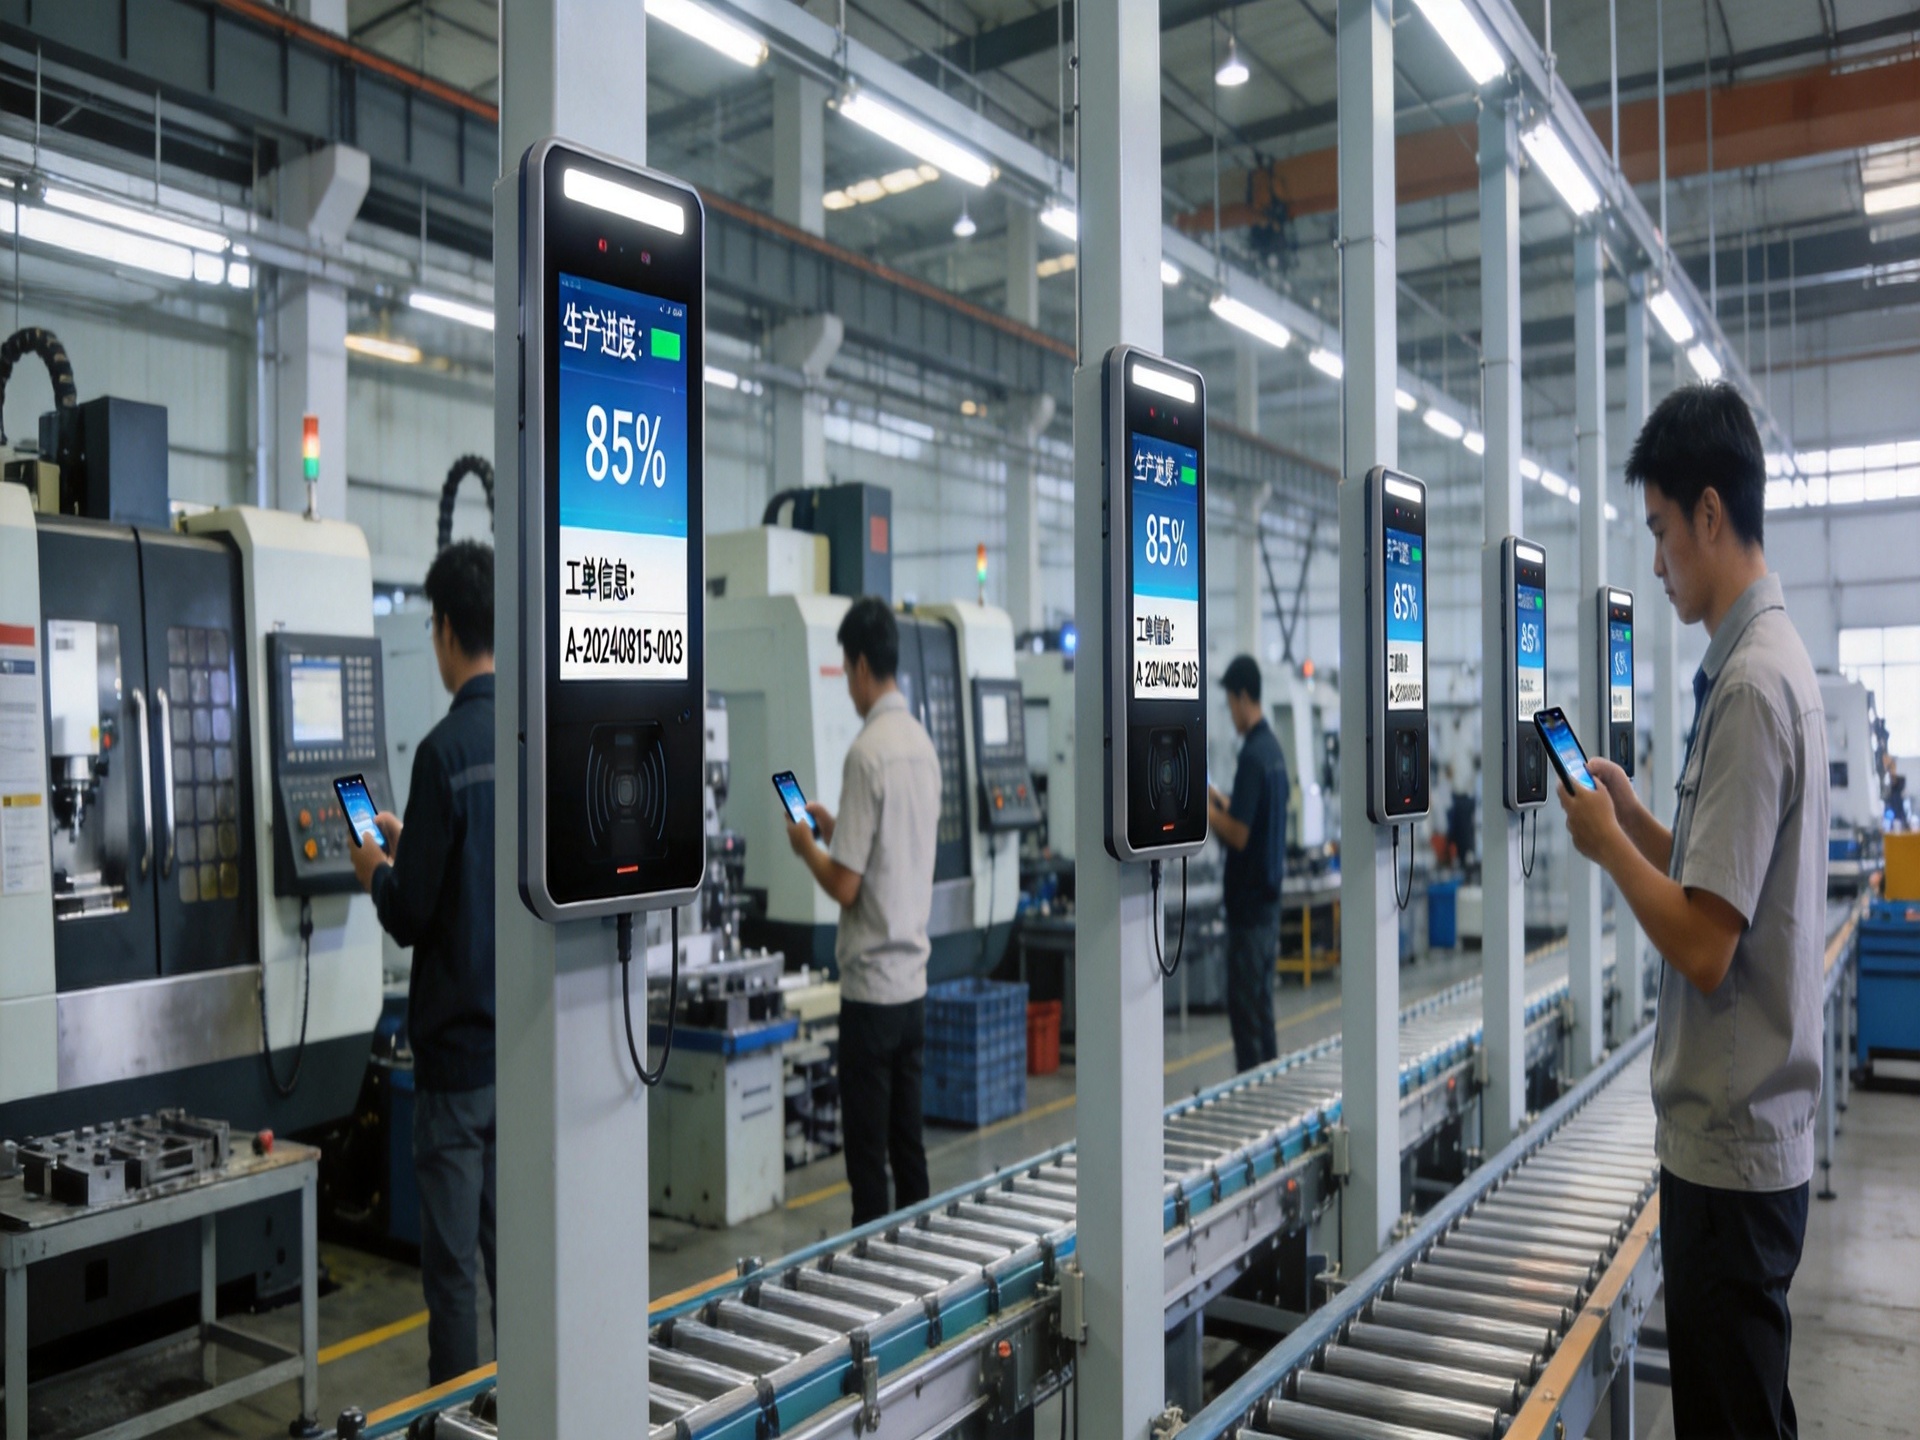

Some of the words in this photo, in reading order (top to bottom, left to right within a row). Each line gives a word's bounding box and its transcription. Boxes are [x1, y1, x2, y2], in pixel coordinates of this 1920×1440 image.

[563, 301, 643, 361] 生产进度：
[585, 404, 666, 489] 85%
[1145, 513, 1188, 567] 85%
[566, 555, 635, 602] 工单信息：
[565, 625, 683, 664] A-20240815-003
